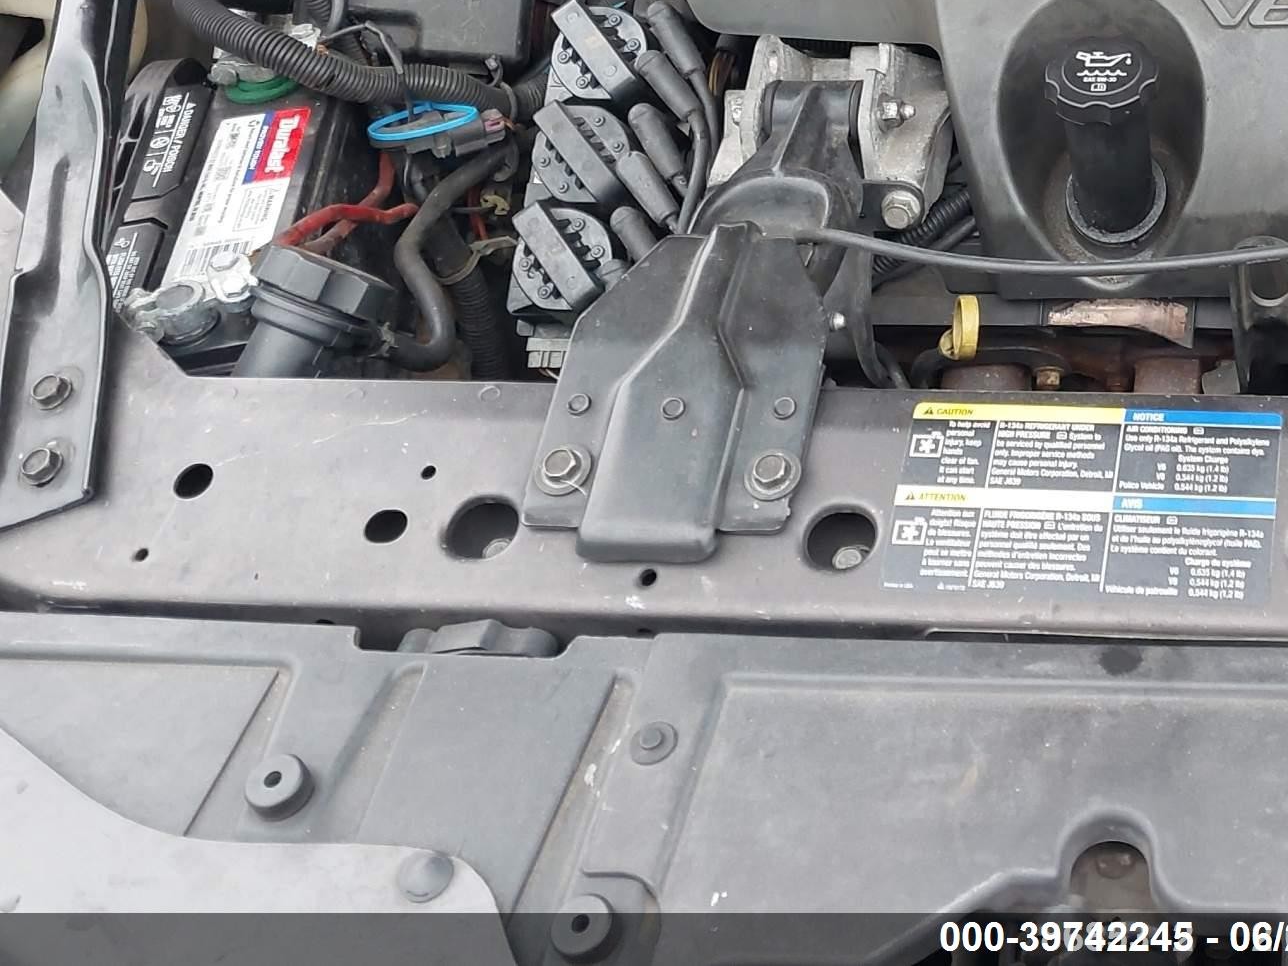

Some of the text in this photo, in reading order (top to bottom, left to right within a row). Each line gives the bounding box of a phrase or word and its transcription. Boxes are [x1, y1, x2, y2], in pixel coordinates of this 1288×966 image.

[175, 110, 194, 139] DANGER
[264, 115, 301, 173] Duralast
[162, 145, 181, 172] POISON
[1133, 413, 1164, 421] NOTICE
[1125, 434, 1137, 442] Use
[1154, 435, 1177, 443] R-134a
[1178, 436, 1214, 444] Refrigerant
[1198, 446, 1221, 454] system
[1177, 455, 1228, 463] System Charge
[1140, 482, 1164, 490] Vehicle
[919, 493, 965, 501] ATTENTION
[1121, 499, 1143, 508] AVIS
[1184, 558, 1209, 566] Charge
